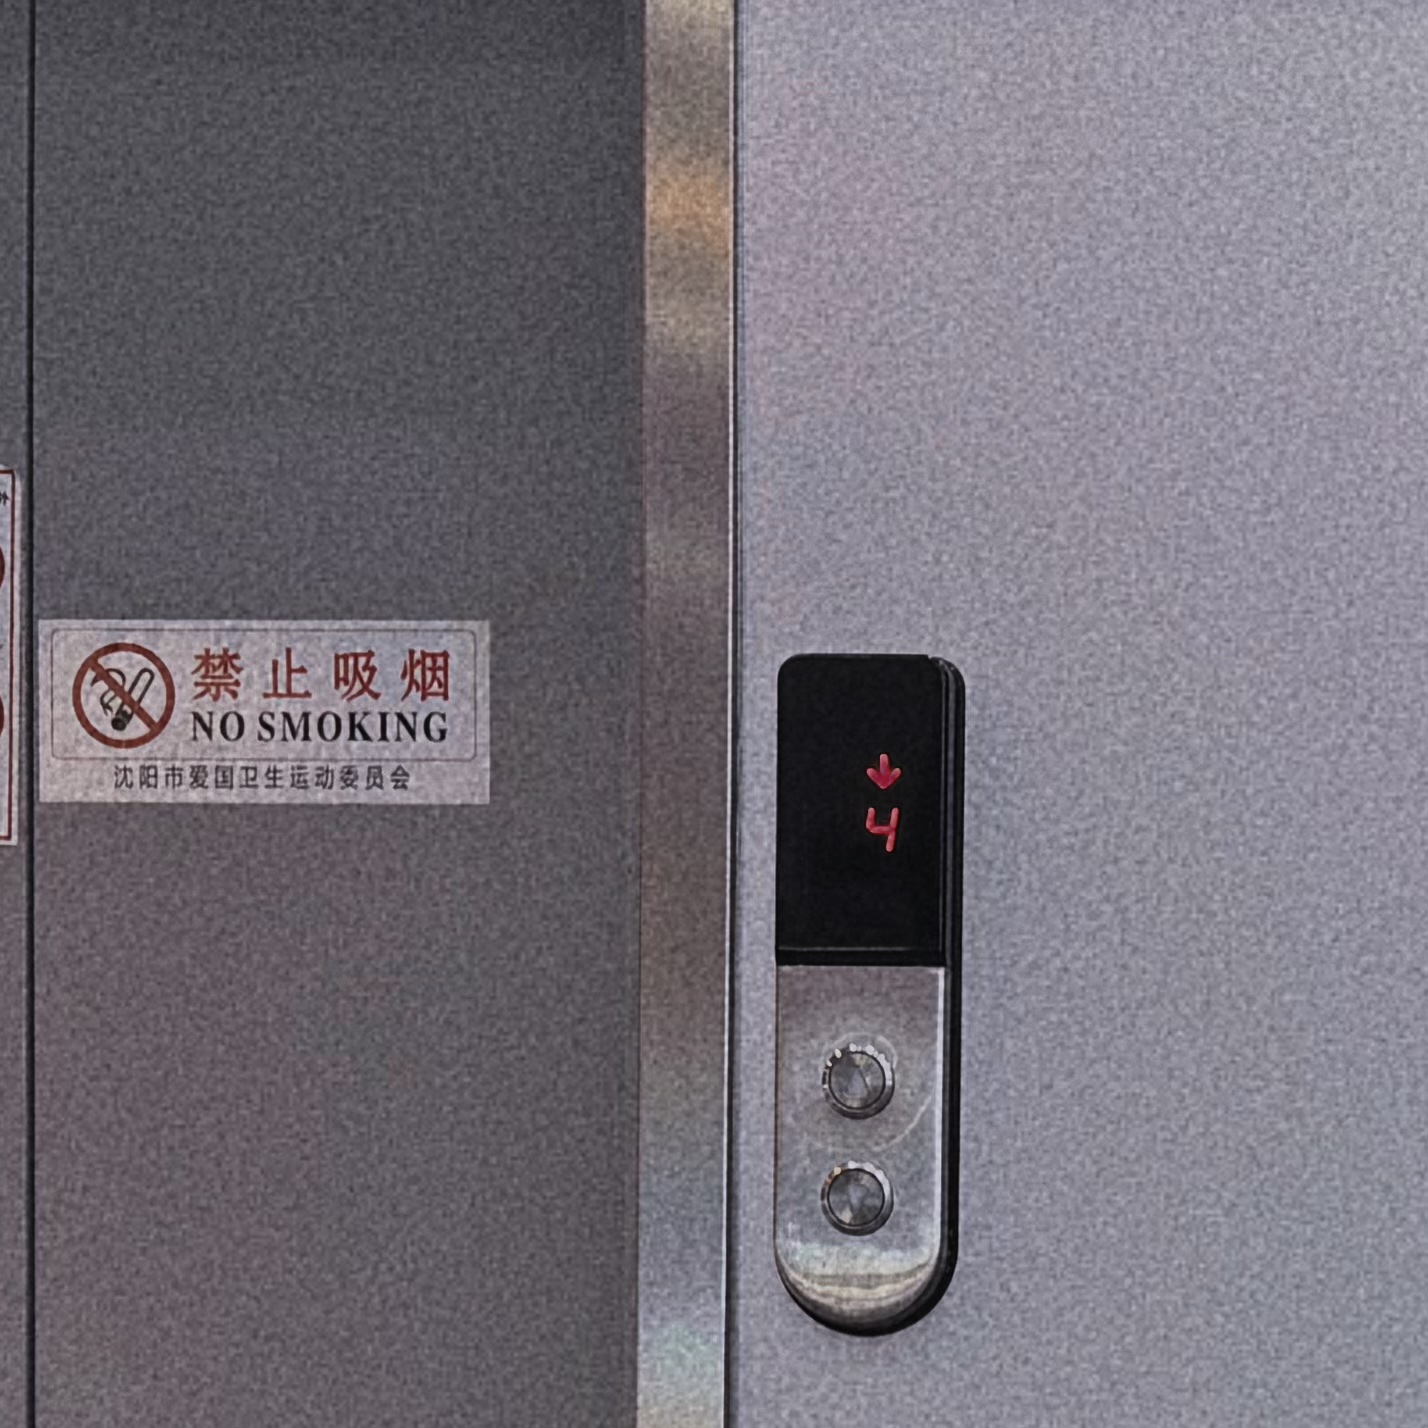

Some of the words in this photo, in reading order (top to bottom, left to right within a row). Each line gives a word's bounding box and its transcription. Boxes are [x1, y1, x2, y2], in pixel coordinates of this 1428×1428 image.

[191, 647, 450, 702] 禁止吸烟
[191, 710, 246, 742] NO
[257, 710, 448, 743] SMOKING
[113, 764, 411, 790] 沈阳市爱国卫生运动委员会
[865, 807, 899, 853] 4
